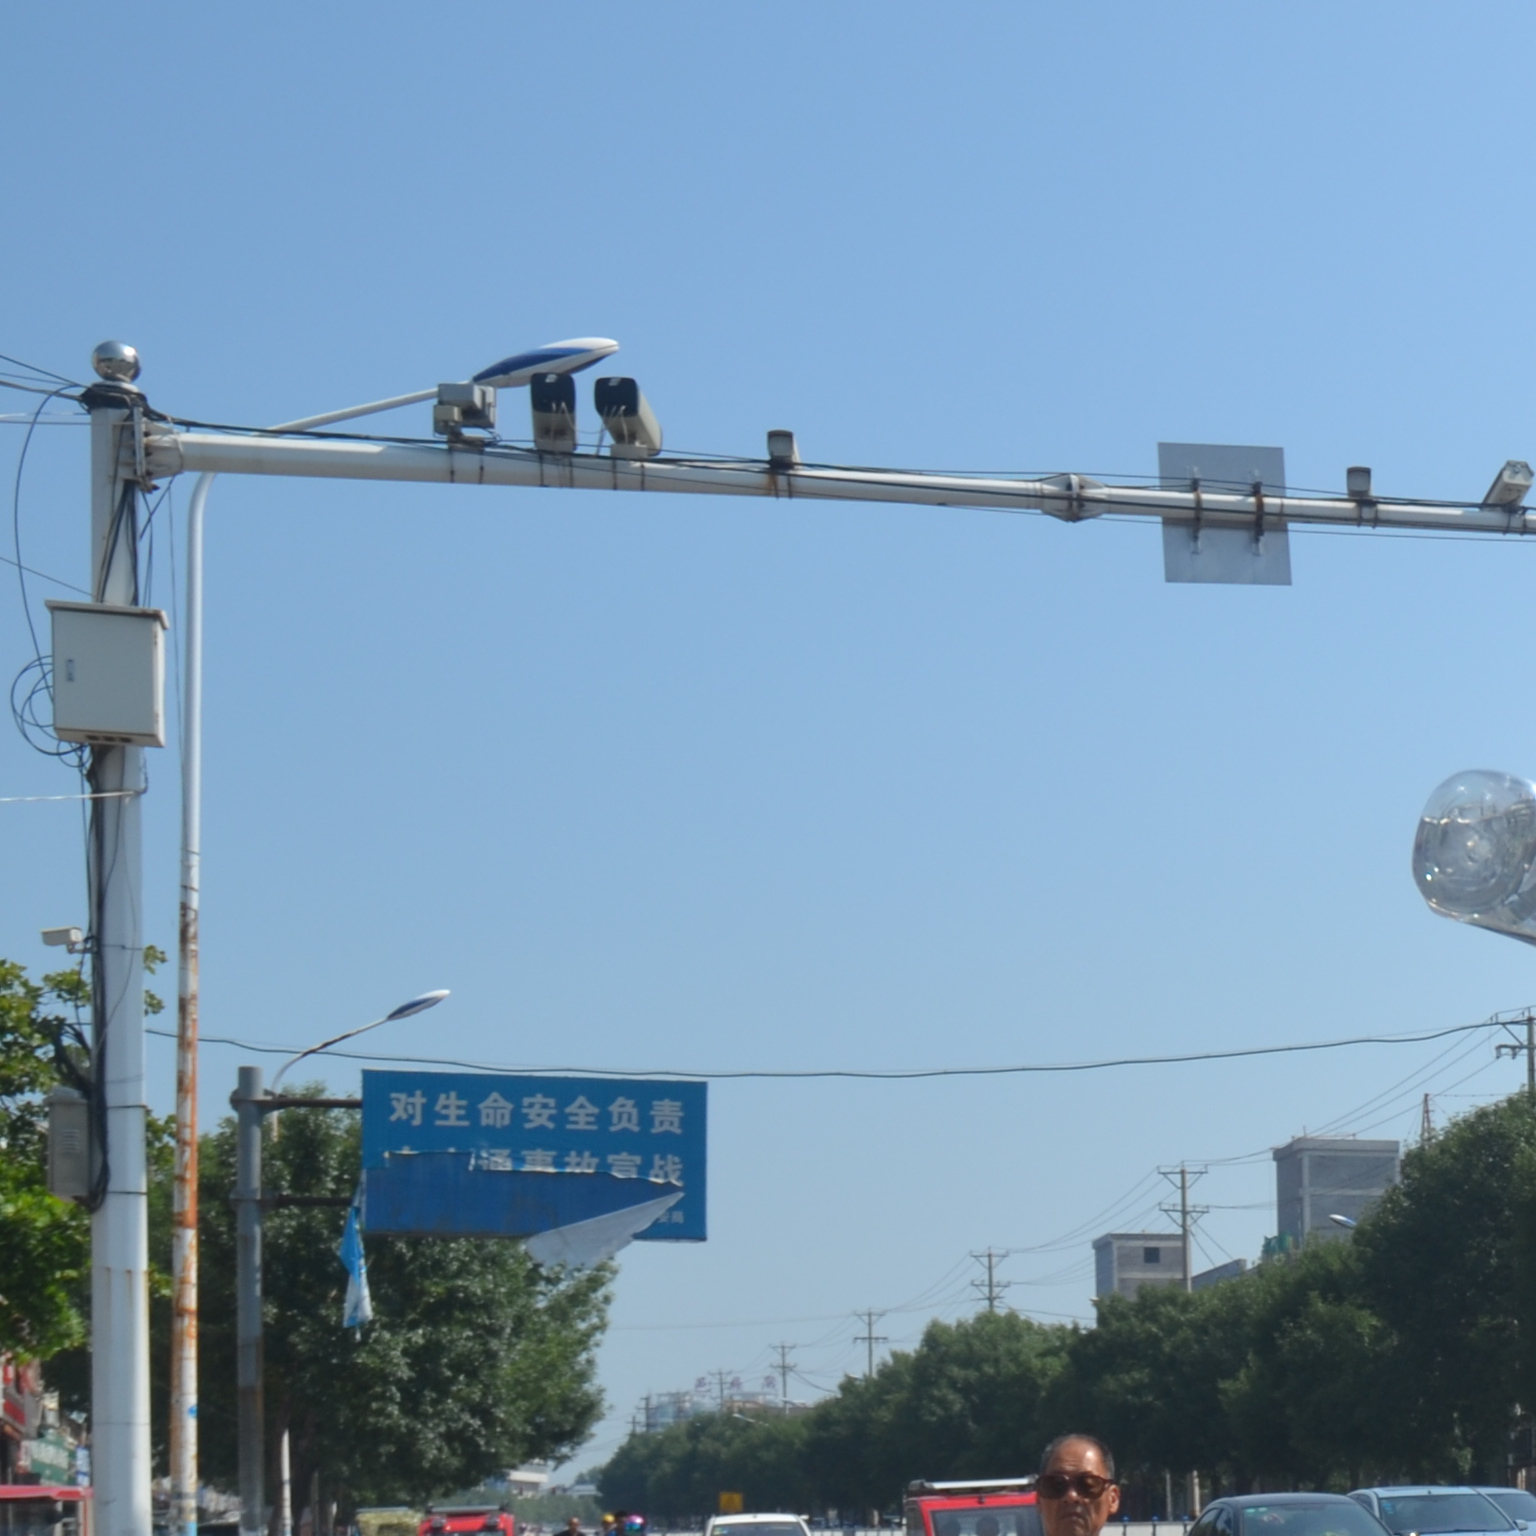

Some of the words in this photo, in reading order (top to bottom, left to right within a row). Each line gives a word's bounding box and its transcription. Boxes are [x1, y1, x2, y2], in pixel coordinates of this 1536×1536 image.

[389, 1089, 685, 1135] 对生命安全负责
